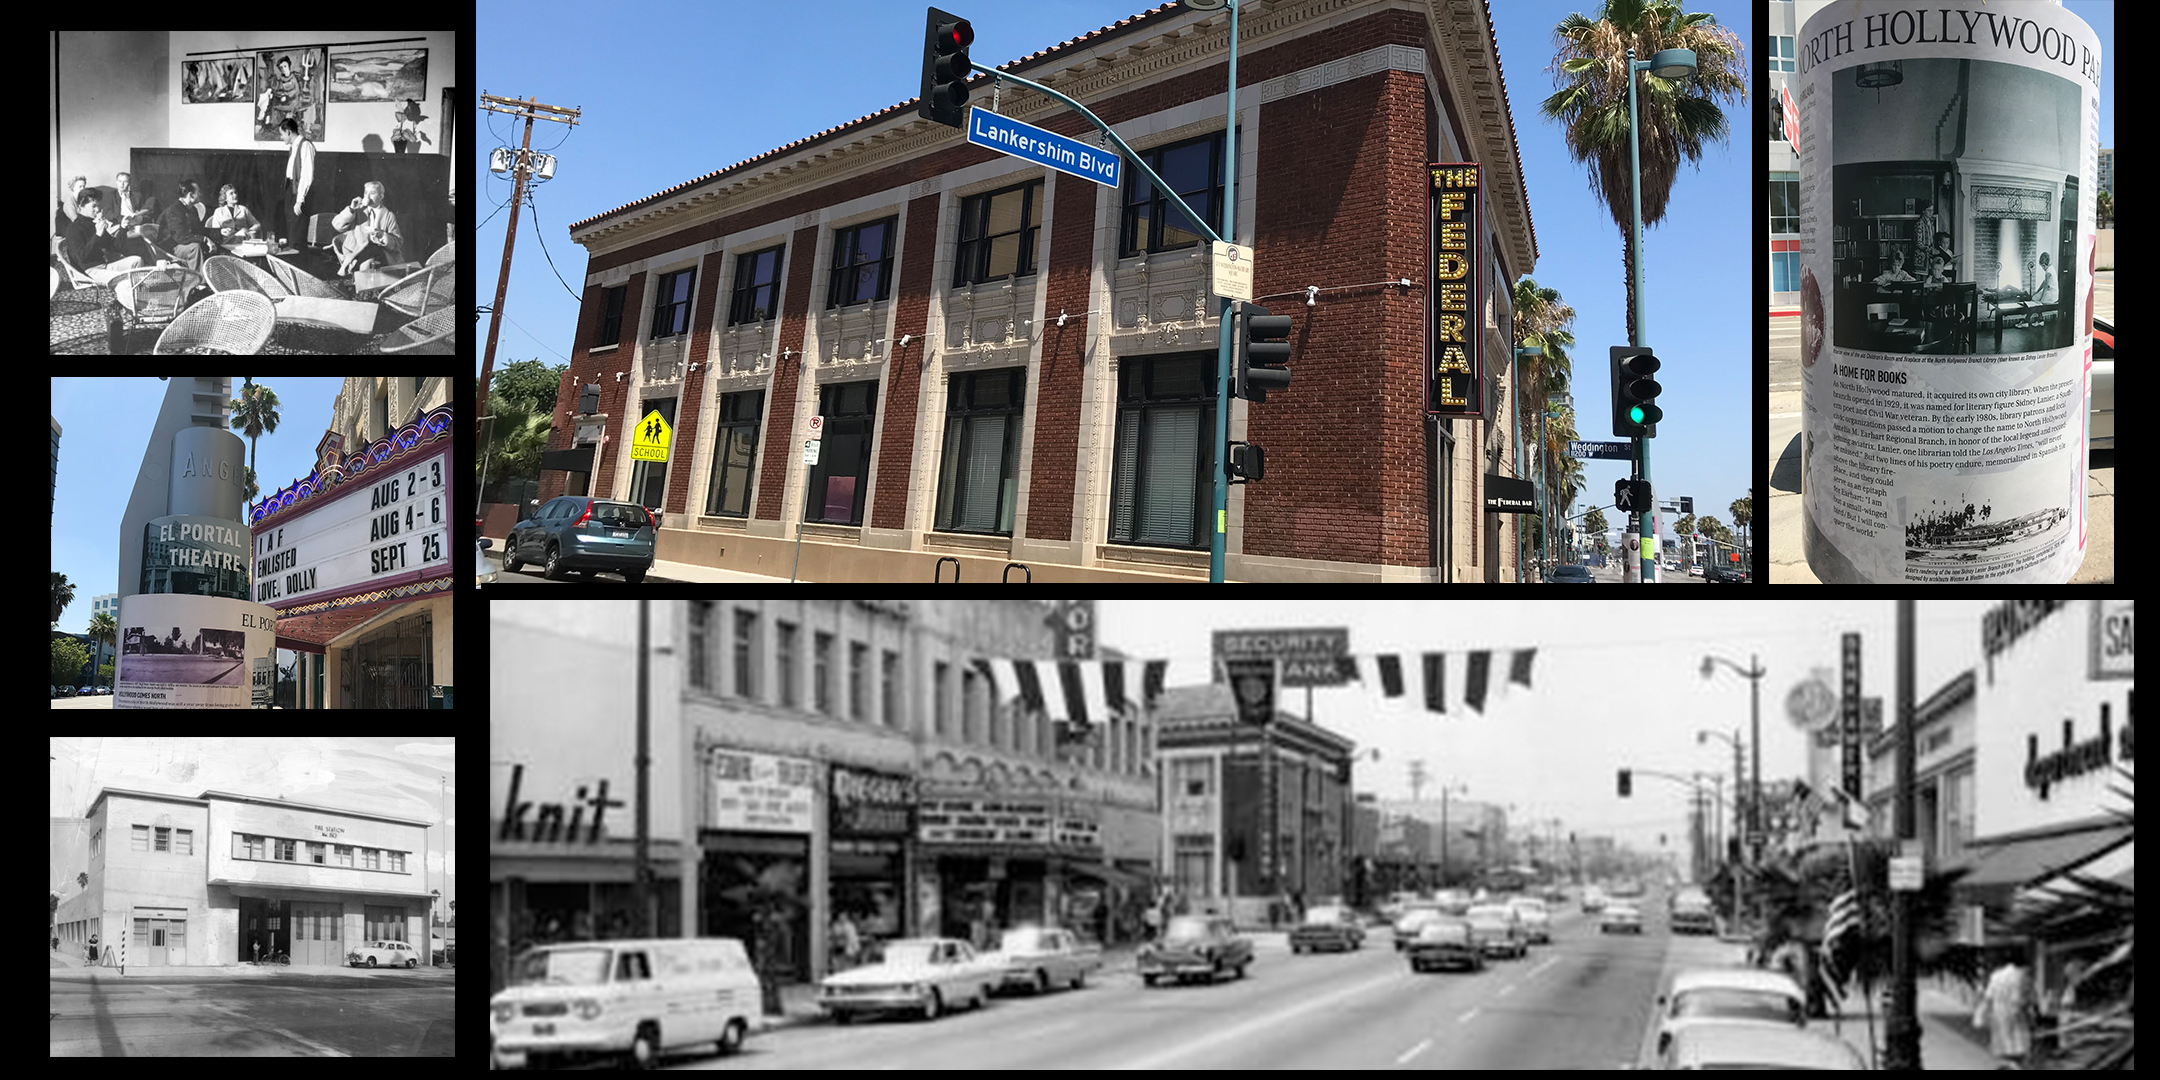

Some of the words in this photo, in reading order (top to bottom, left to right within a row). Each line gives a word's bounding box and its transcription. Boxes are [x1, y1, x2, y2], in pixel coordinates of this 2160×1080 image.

[1864, 9, 2076, 66] HOLLYWOOD
[976, 117, 1075, 166] Lankershim
[1080, 152, 1114, 178] Blvd
[1430, 168, 1478, 188] THE
[1436, 192, 1472, 406] FEDERAL
[1833, 364, 1838, 375] A
[1840, 364, 1858, 379] HOME
[1860, 368, 1875, 382] FOR
[1878, 370, 1907, 384] BOOKS
[1840, 381, 1855, 391] North
[1857, 385, 1890, 395] Hollywood
[1934, 392, 1966, 400] acquired
[1995, 390, 2008, 398] city
[1852, 396, 1874, 405] opened
[1884, 400, 1902, 409] 1929,
[1966, 403, 1993, 411] literary
[1994, 402, 2014, 410] figure
[2016, 399, 2036, 407] Sidney
[1868, 409, 1884, 418] Civil
[1885, 411, 1899, 420] War
[1932, 415, 1941, 424] By
[1956, 415, 1975, 423] early
[2000, 411, 2022, 420] library
[2023, 408, 2045, 419] patrons
[1845, 416, 1886, 430] organizations
[1956, 426, 1982, 435] change
[2024, 419, 2041, 428] North
[1861, 430, 1884, 440] Earhart
[1886, 434, 1916, 444] Regional
[1918, 437, 1947, 446] Branch,
[2003, 434, 2018, 442] local
[2020, 430, 2040, 440] legend
[634, 447, 665, 458] SCHOOL
[1570, 442, 1618, 454] Weddington
[1878, 444, 1902, 454] Lanier,
[1918, 448, 1951, 456] librarian
[1994, 446, 2016, 455] Angeles
[1859, 462, 1880, 474] library
[1864, 453, 1875, 461] But
[1890, 457, 1906, 466] lines
[1930, 461, 1954, 470] poetry
[1986, 452, 2030, 466] memorialized
[1861, 474, 1874, 484] they
[1862, 486, 1887, 497] epitaph
[1498, 498, 1521, 507] FEDERAL
[1846, 502, 1887, 518] small-winged
[267, 534, 273, 552] A
[278, 528, 283, 547] F
[371, 479, 399, 510] AUG
[1861, 518, 1872, 526] will
[1874, 521, 1888, 529] con-
[160, 524, 176, 542] EL
[180, 524, 241, 548] PORTAL
[258, 548, 297, 578] ENLISTED
[371, 510, 399, 542] AUG
[170, 548, 240, 573] THEATRE
[258, 580, 280, 602] LOVE,
[286, 568, 317, 594] DOLLY
[371, 542, 406, 574] SEPT
[422, 533, 440, 562] 25
[242, 613, 256, 628] EL
[1066, 600, 1088, 655] OR
[1224, 636, 1337, 650] SECURITY
[1286, 662, 1338, 677] ANK
[498, 764, 624, 844] knit
